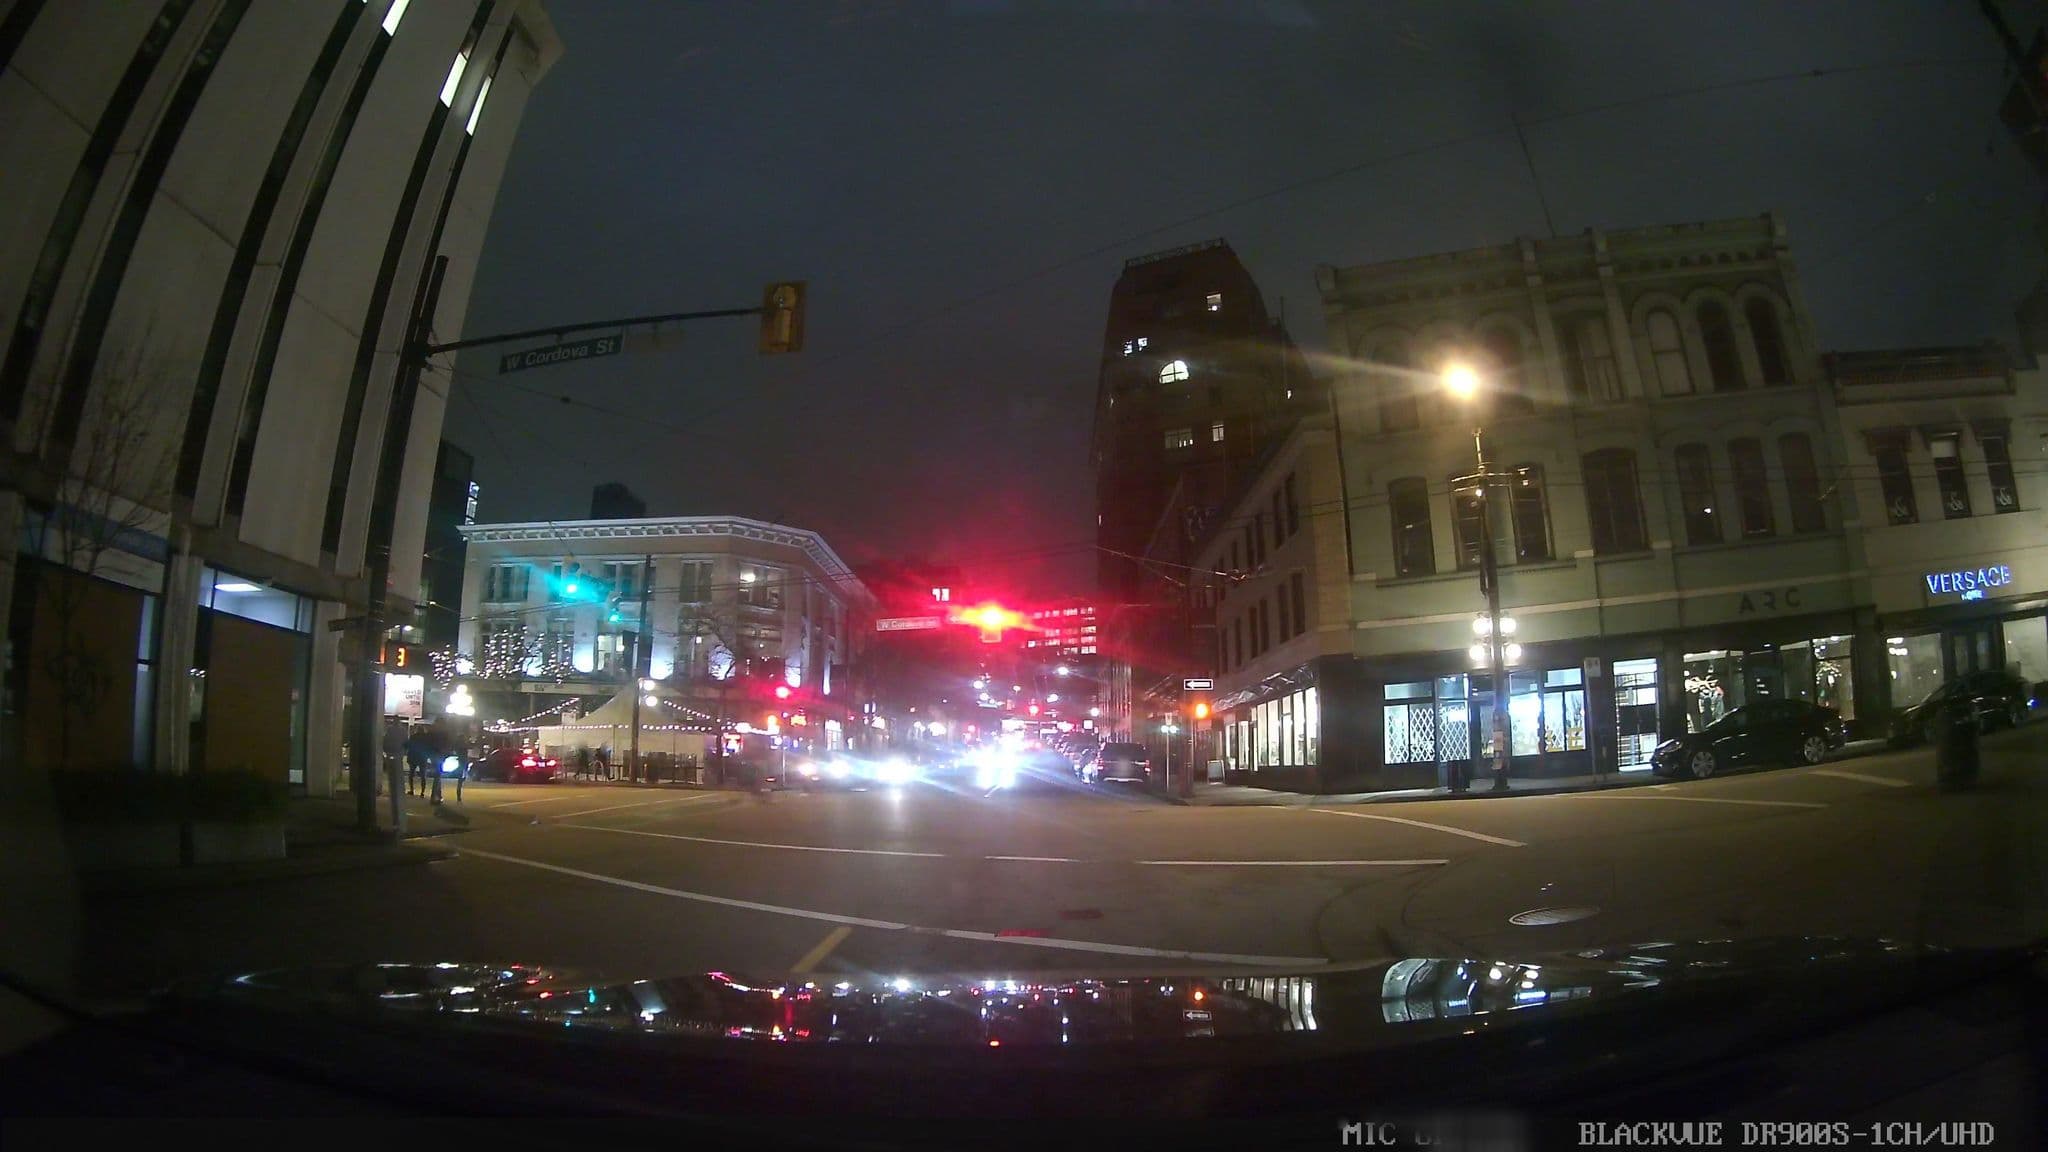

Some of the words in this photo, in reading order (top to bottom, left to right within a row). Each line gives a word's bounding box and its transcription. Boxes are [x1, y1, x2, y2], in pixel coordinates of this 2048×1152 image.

[505, 355, 520, 370] W
[525, 344, 589, 366] Cordova
[596, 338, 614, 355] St
[1926, 564, 2012, 594] VERSACE
[1739, 588, 1801, 614] ARC
[396, 647, 406, 667] 3
